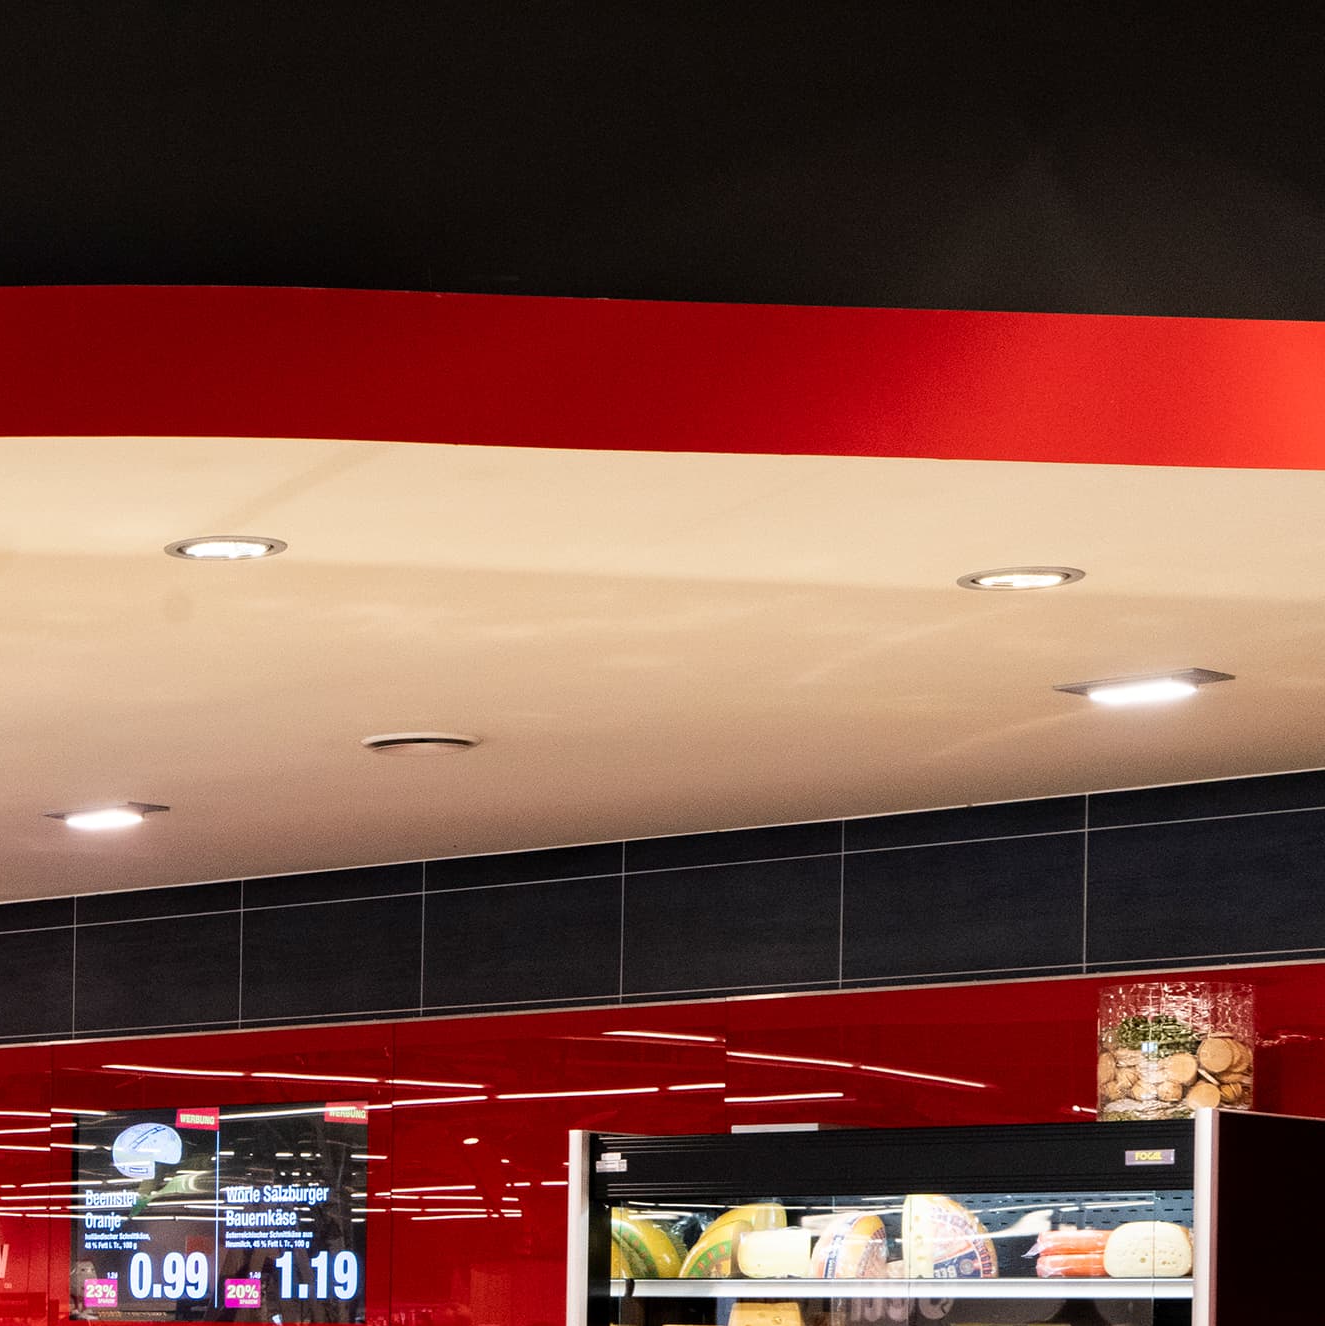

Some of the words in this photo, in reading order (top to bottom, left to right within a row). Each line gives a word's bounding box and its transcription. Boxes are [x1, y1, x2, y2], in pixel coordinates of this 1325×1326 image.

[180, 1113, 215, 1125] WERBUNG
[85, 1189, 139, 1206] Beemster
[263, 1185, 329, 1205] Salzburger
[85, 1212, 121, 1231] Oranje
[226, 1209, 297, 1226] Bauernkäse
[130, 1252, 208, 1299] 0.99
[275, 1251, 358, 1300] 1.19
[85, 1284, 116, 1298] 23%
[227, 1284, 259, 1299] 20%
